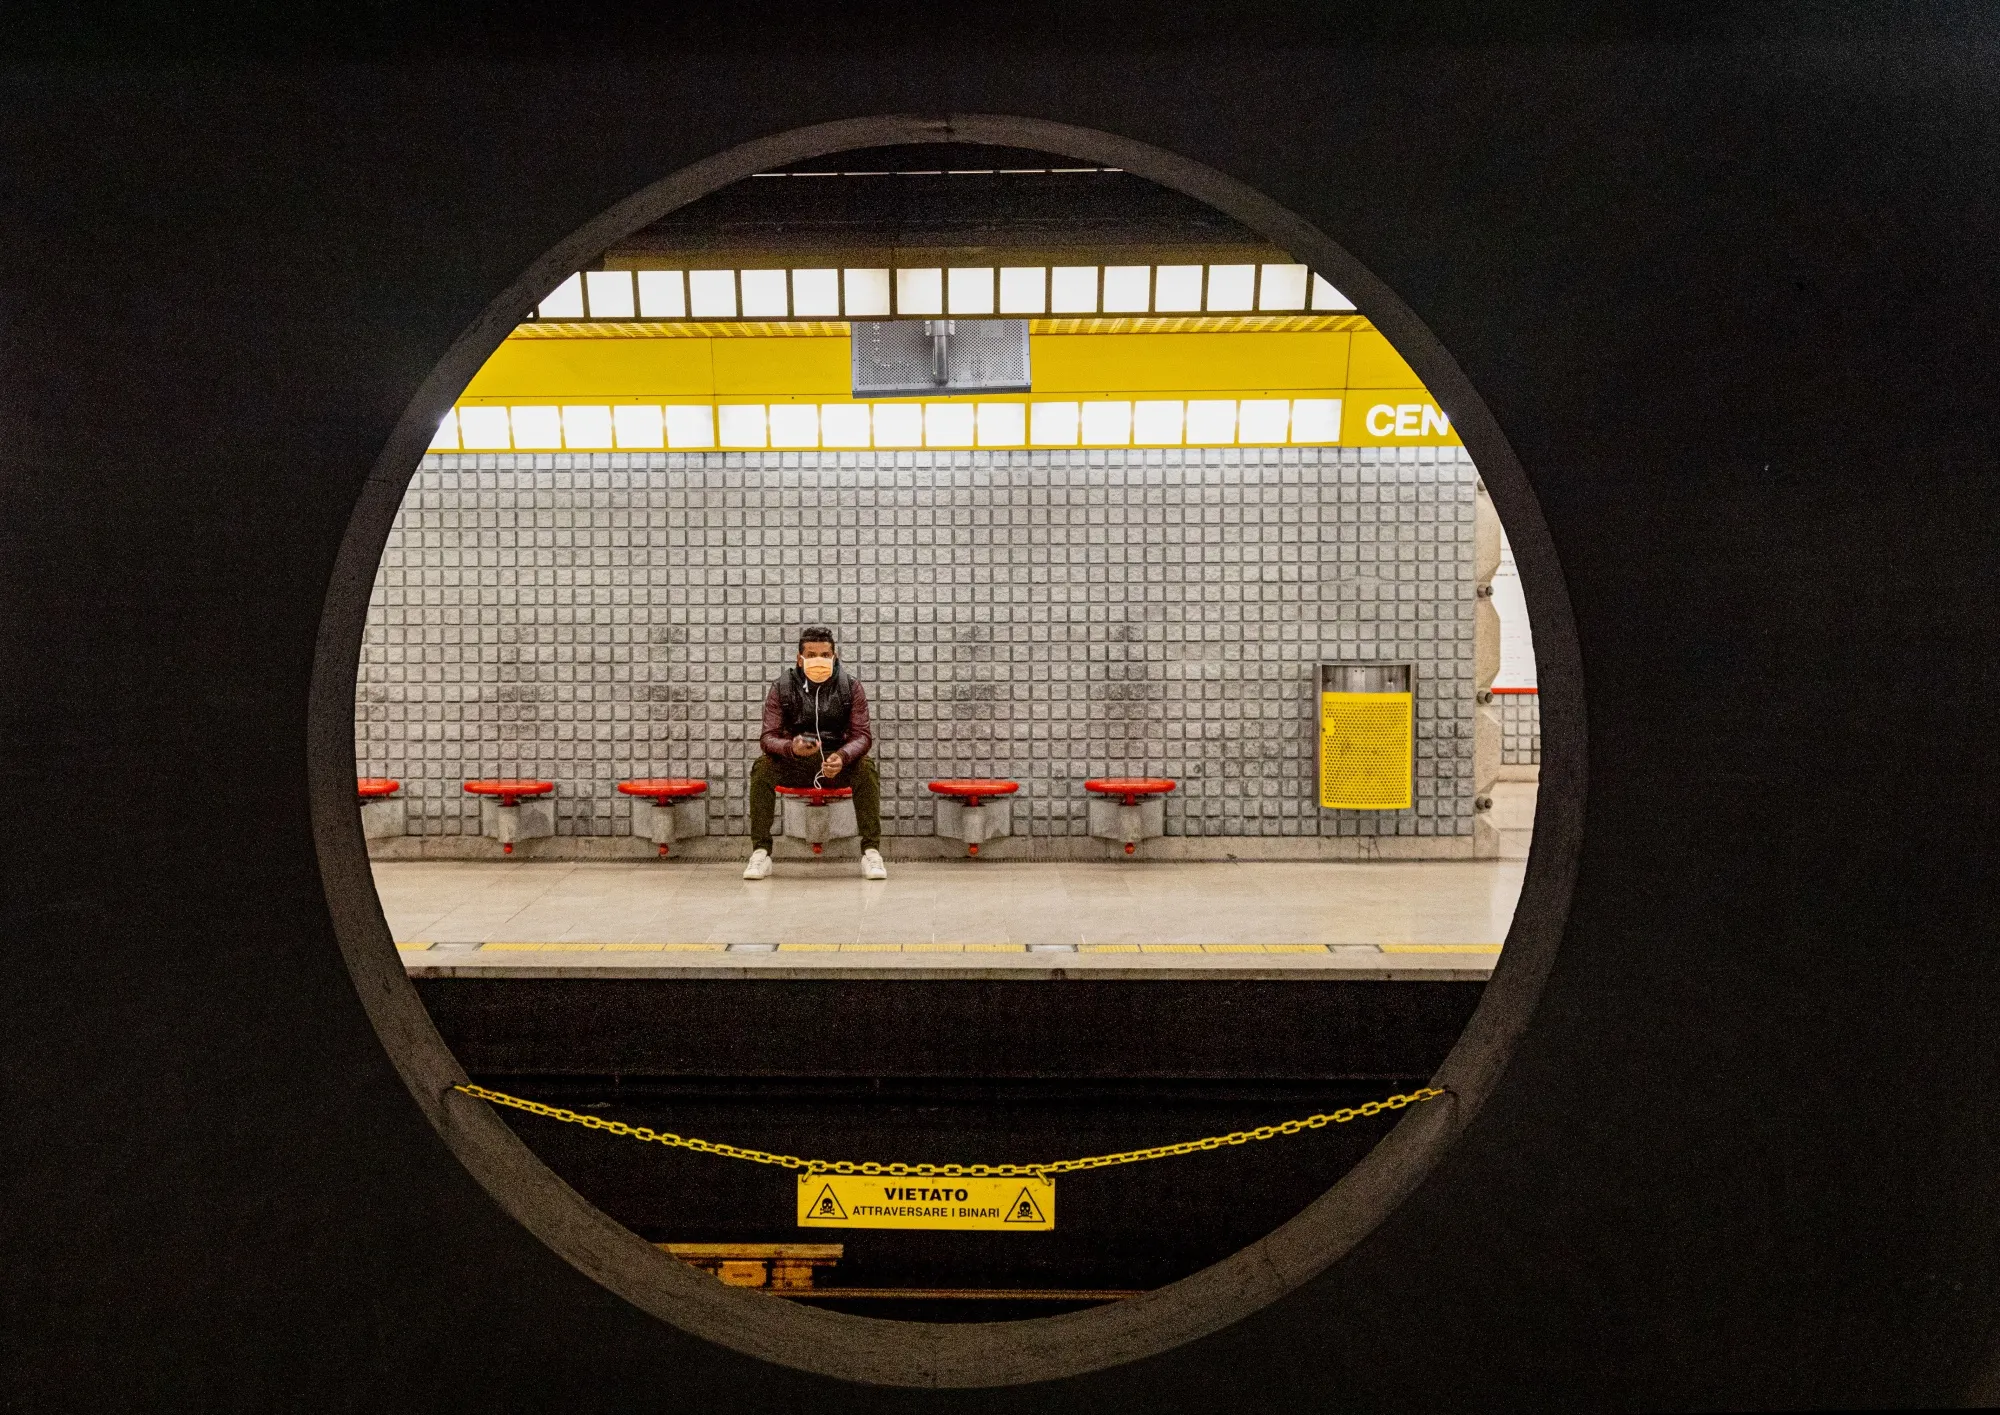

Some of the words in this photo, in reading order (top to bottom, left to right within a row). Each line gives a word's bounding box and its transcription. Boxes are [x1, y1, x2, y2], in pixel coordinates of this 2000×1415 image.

[1366, 404, 1449, 436] CEN
[884, 1187, 968, 1201] VIETATO
[852, 1206, 947, 1217] ATTRAVERSARE
[959, 1208, 1000, 1218] BINARI
